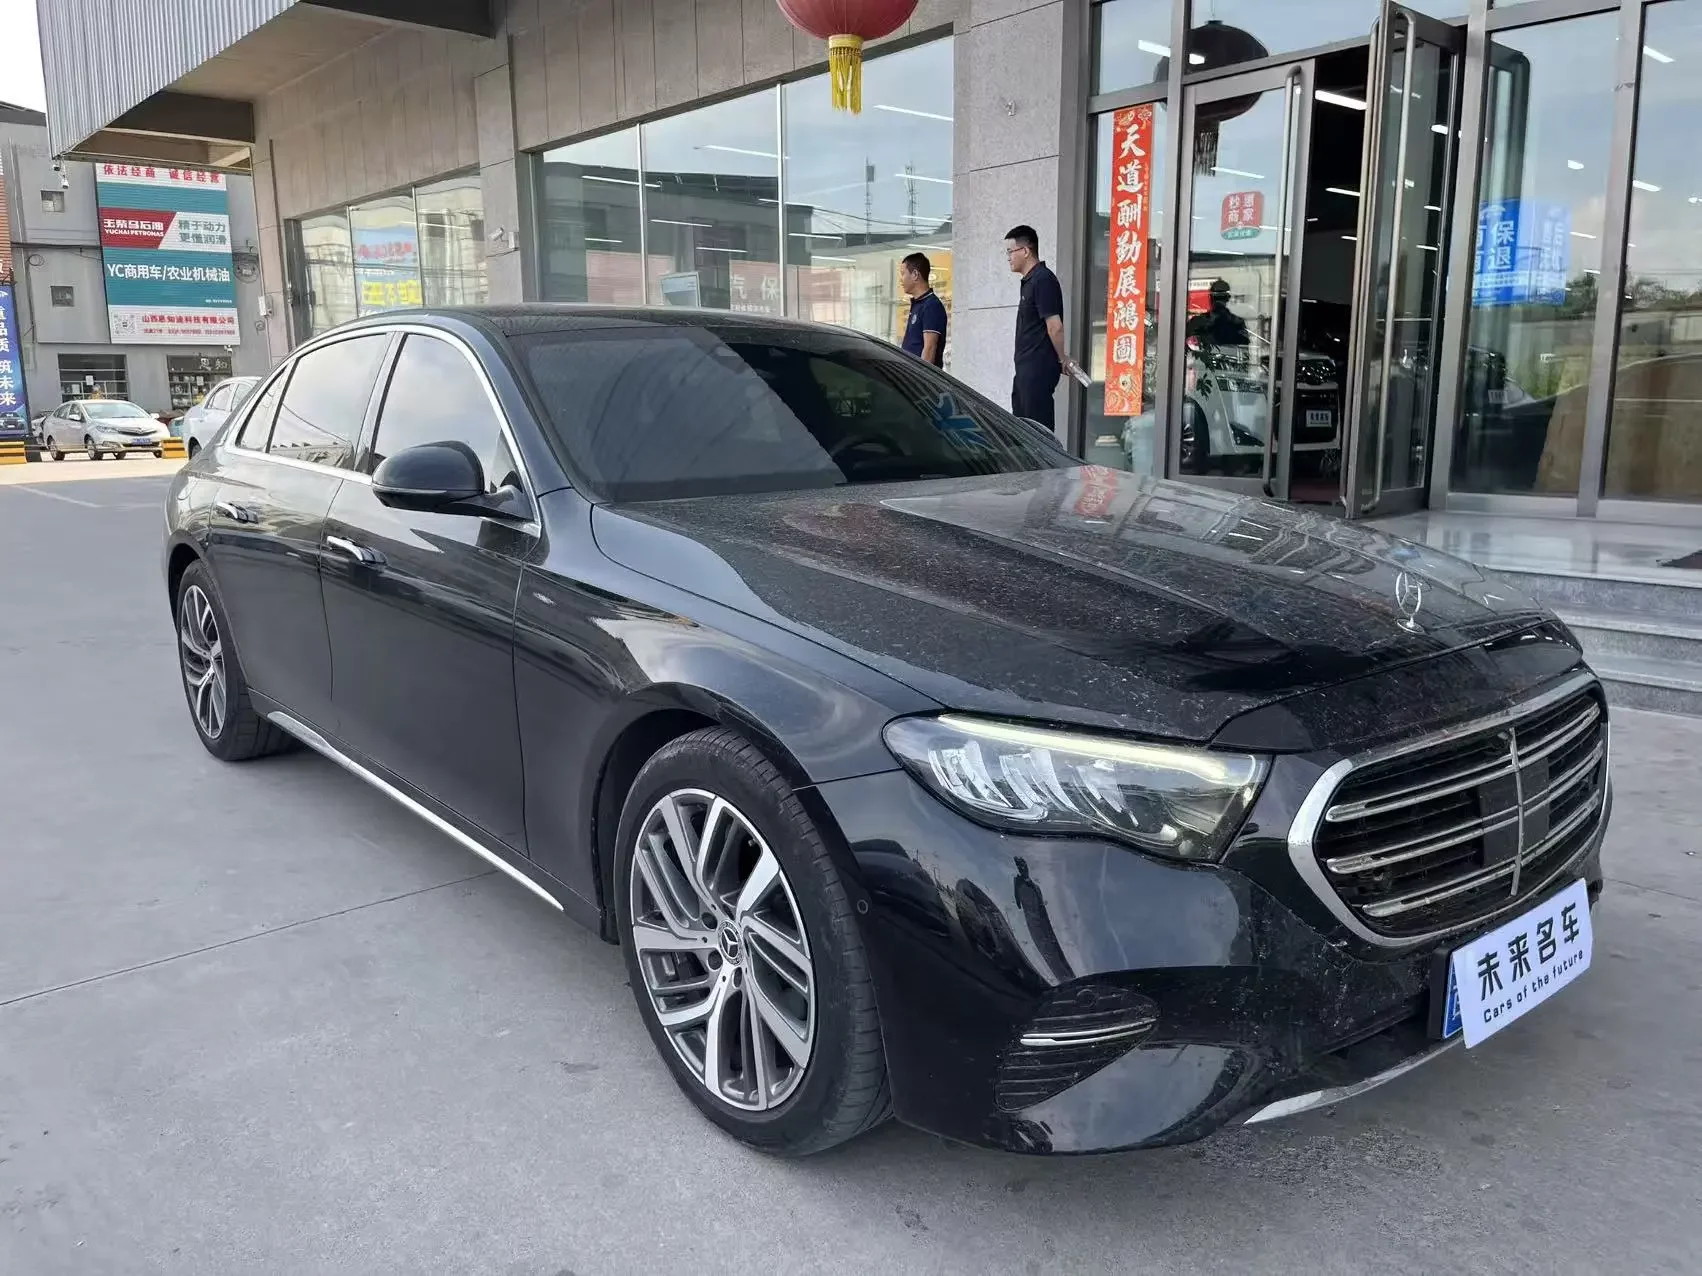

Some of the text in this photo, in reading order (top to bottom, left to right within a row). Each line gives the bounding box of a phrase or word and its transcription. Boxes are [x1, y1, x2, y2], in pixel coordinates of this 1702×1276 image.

[105, 228, 165, 238] YUCHAI PETRONAS
[1477, 902, 1580, 1002] 未来名车
[1483, 998, 1513, 1023] Cars
[1516, 984, 1528, 1003] of
[1532, 974, 1549, 992] the
[1553, 949, 1583, 979] future
